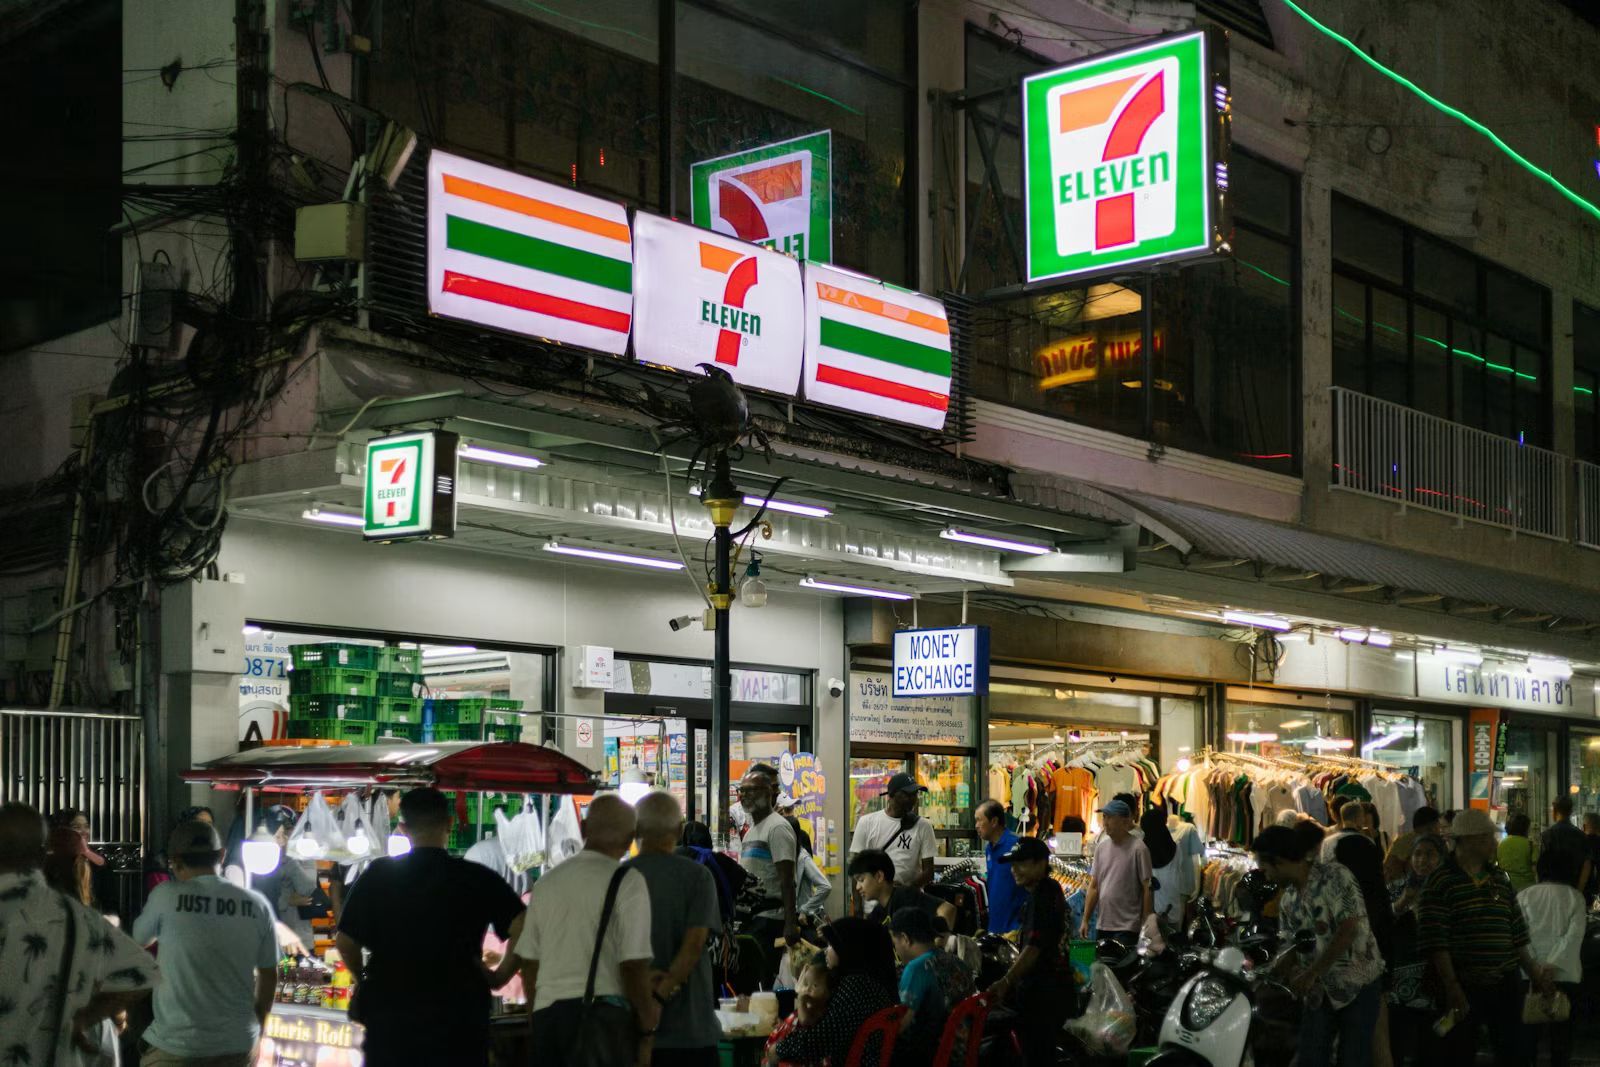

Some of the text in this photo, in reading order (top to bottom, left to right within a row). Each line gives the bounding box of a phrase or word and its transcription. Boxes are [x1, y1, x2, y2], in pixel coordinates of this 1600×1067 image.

[910, 634, 960, 660] MONEY
[859, 677, 889, 697] บริษัท
[897, 663, 973, 691] EXCHANGE
[1474, 724, 1490, 766] TATTOO
[176, 894, 256, 919] JUST DO IT.
[316, 1021, 353, 1047] Roti
